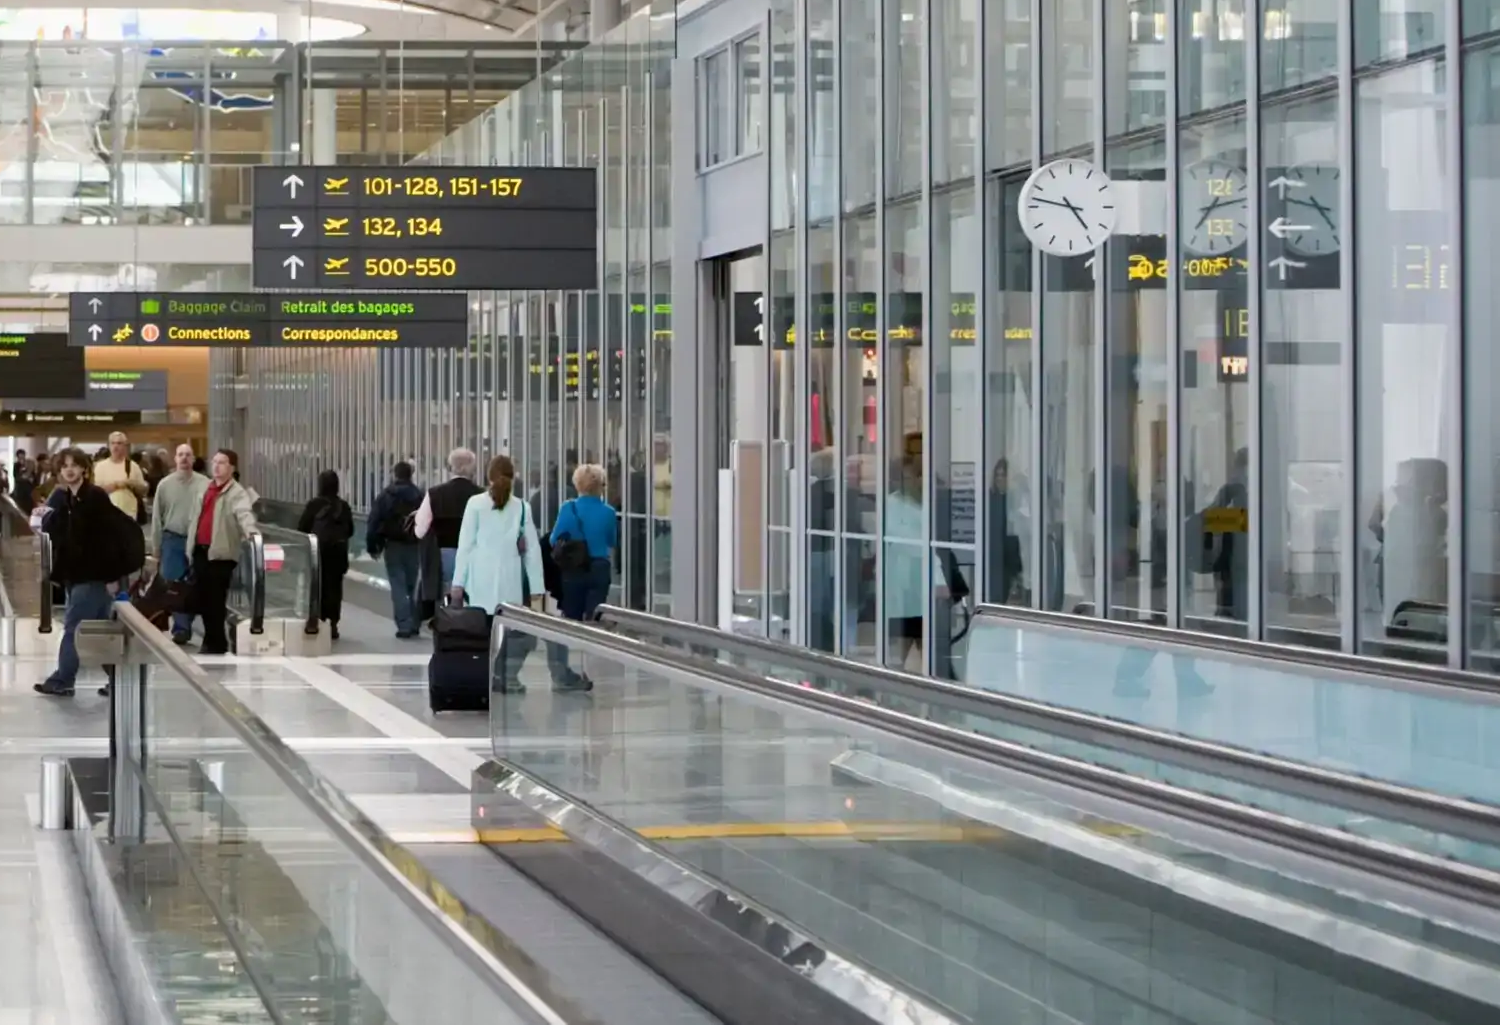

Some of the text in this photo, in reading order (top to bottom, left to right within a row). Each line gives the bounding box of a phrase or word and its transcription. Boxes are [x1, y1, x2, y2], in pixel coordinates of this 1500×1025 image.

[363, 177, 522, 198] 101-128, 151-157
[363, 217, 443, 238] 132, 134
[365, 258, 457, 277] 500-550
[168, 300, 266, 315] Baggage Claim
[282, 300, 414, 316] Retrait des bagages
[167, 326, 251, 341] Connections
[282, 327, 398, 342] Correspondances
